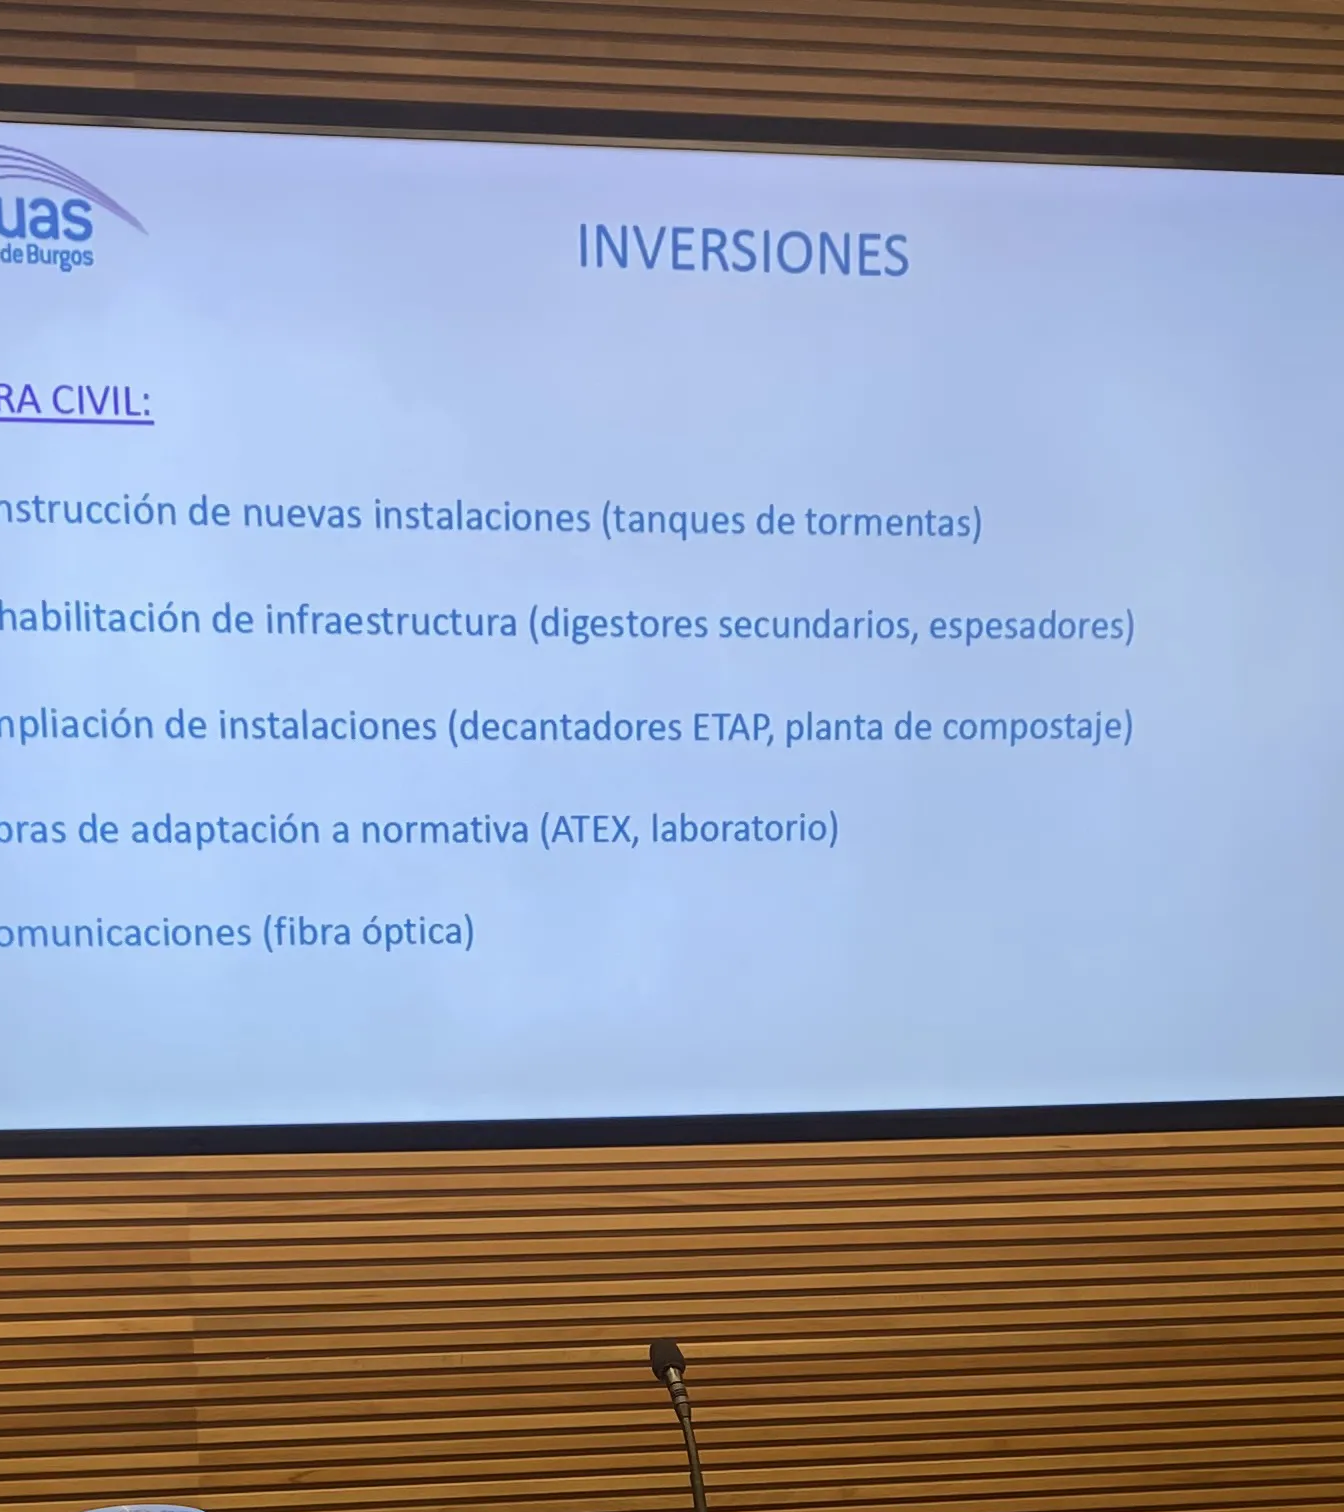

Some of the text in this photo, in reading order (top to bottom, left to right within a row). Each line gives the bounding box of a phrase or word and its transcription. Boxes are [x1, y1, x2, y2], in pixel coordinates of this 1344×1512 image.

[0, 242, 95, 273] de Burgos
[578, 223, 910, 278] INVERSIONES
[52, 384, 151, 417] CIVIL:
[187, 493, 231, 527] de
[243, 503, 362, 529] nuevas
[374, 497, 591, 533] instalaciones
[602, 499, 746, 542] (tanques
[755, 503, 796, 536] de
[804, 505, 982, 545] tormentas)
[211, 601, 255, 635] de
[266, 602, 517, 637] infraestructura
[529, 603, 709, 646] (digestores
[718, 607, 919, 646] secundarios,
[929, 608, 1135, 647] espesadores)
[164, 707, 208, 740] de
[219, 707, 437, 741] instalaciones
[448, 707, 683, 749] (decantadores
[693, 712, 775, 748] ETAP,
[785, 710, 883, 749] planta
[894, 709, 933, 741] de
[942, 708, 1133, 748] compostaje)
[77, 811, 119, 845] de
[130, 812, 320, 852] adaptación
[332, 821, 350, 844] a
[361, 813, 529, 845] normativa
[540, 811, 639, 851] (ATEX,
[652, 809, 839, 849] laboratorio)
[263, 914, 351, 954] (fibra
[362, 913, 474, 953] óptica)
